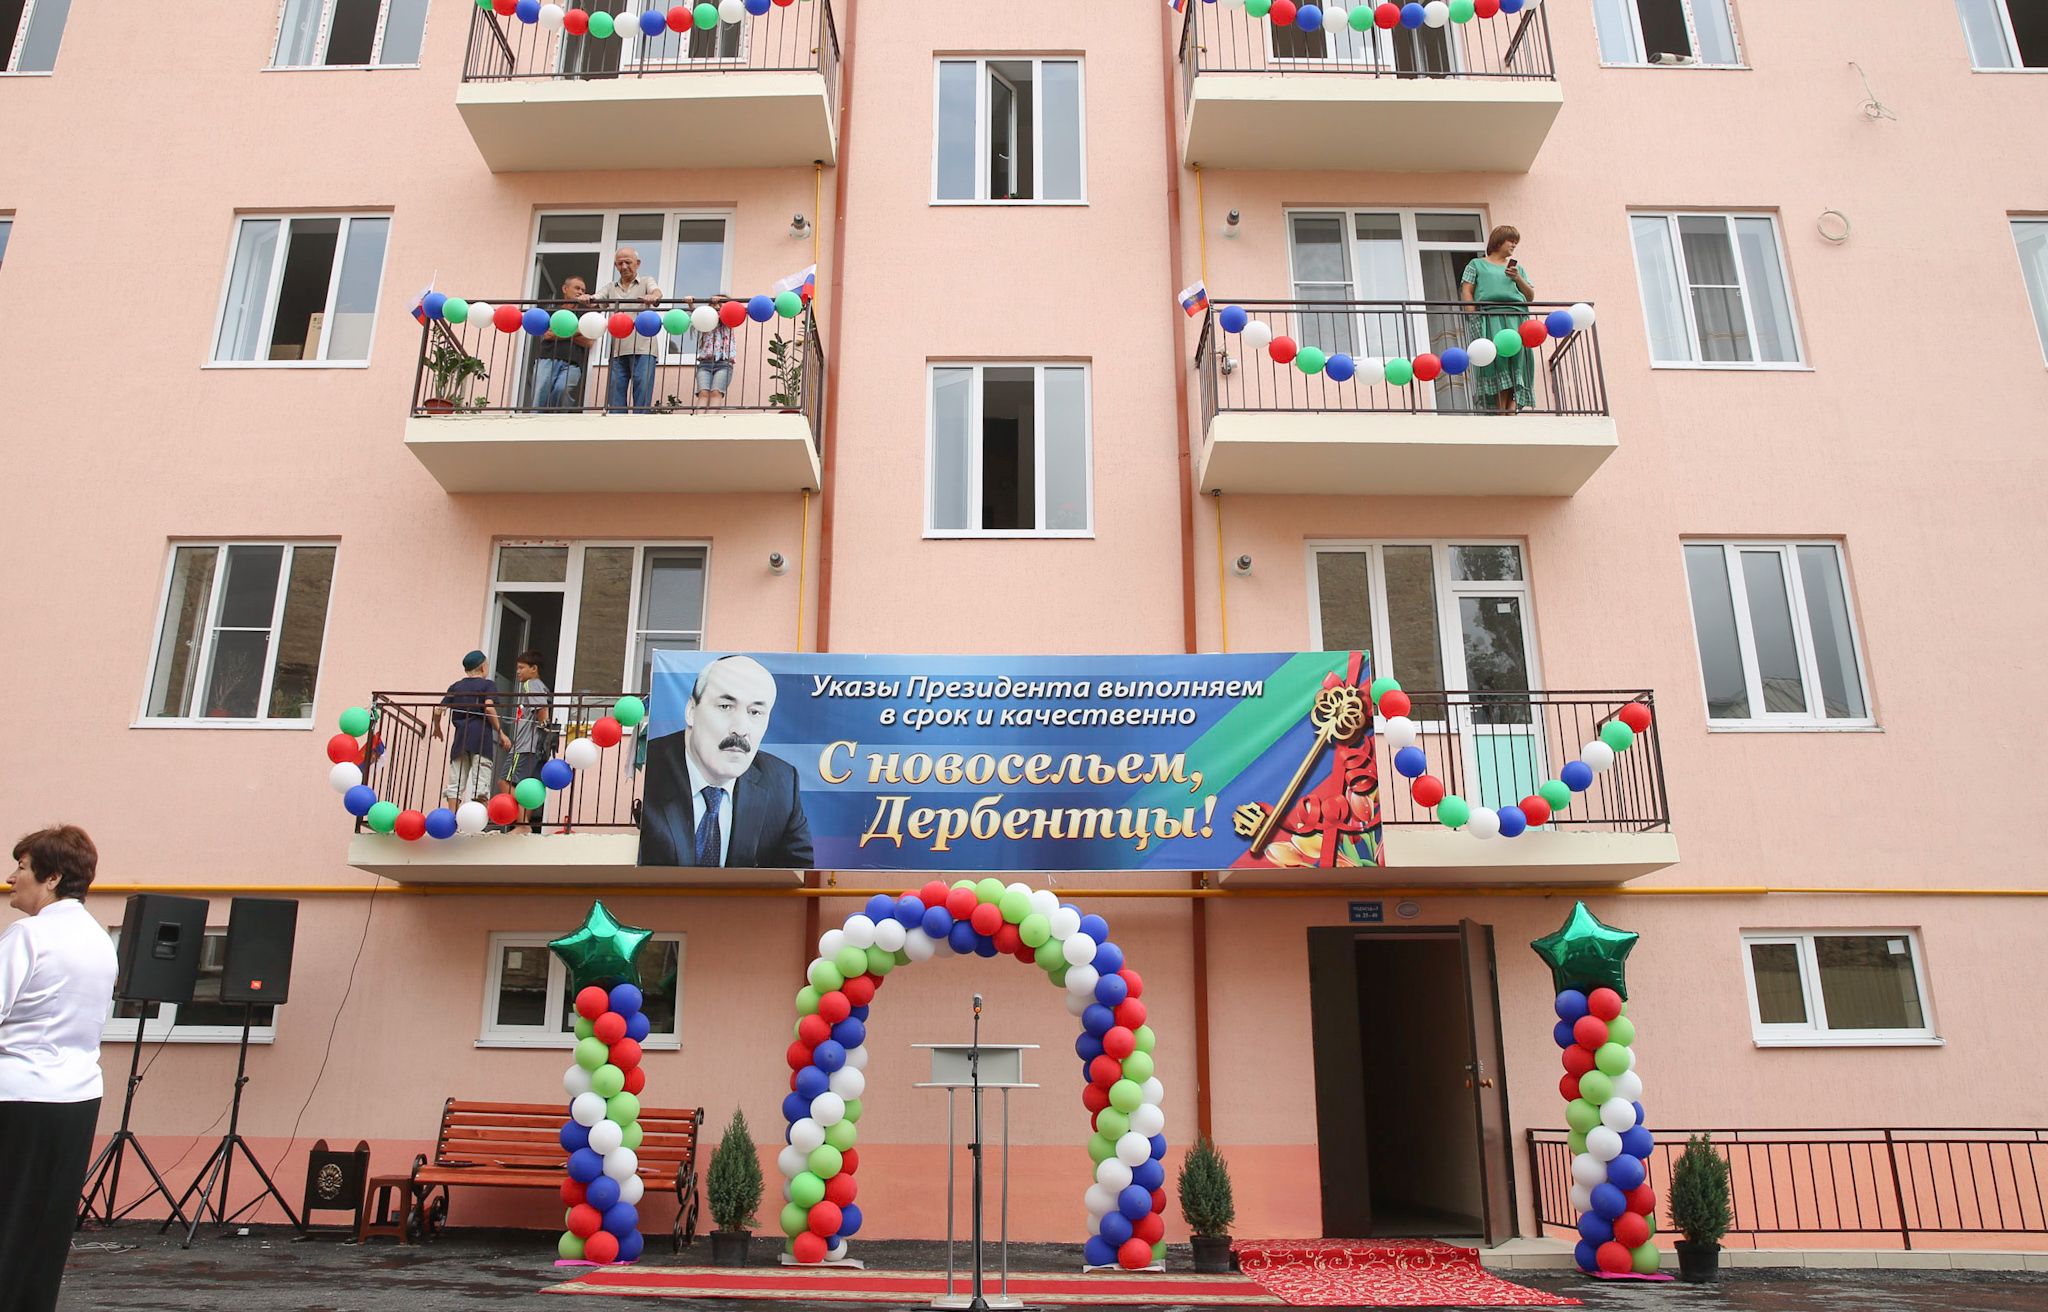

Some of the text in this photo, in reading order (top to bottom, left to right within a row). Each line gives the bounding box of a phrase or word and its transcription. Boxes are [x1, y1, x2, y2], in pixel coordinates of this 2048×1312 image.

[811, 674, 1264, 703] Указы Президента выполняем
[879, 706, 1196, 730] в срок и качественно
[818, 740, 1204, 792] С новосельем,
[860, 794, 1218, 850] Дербентцы!
